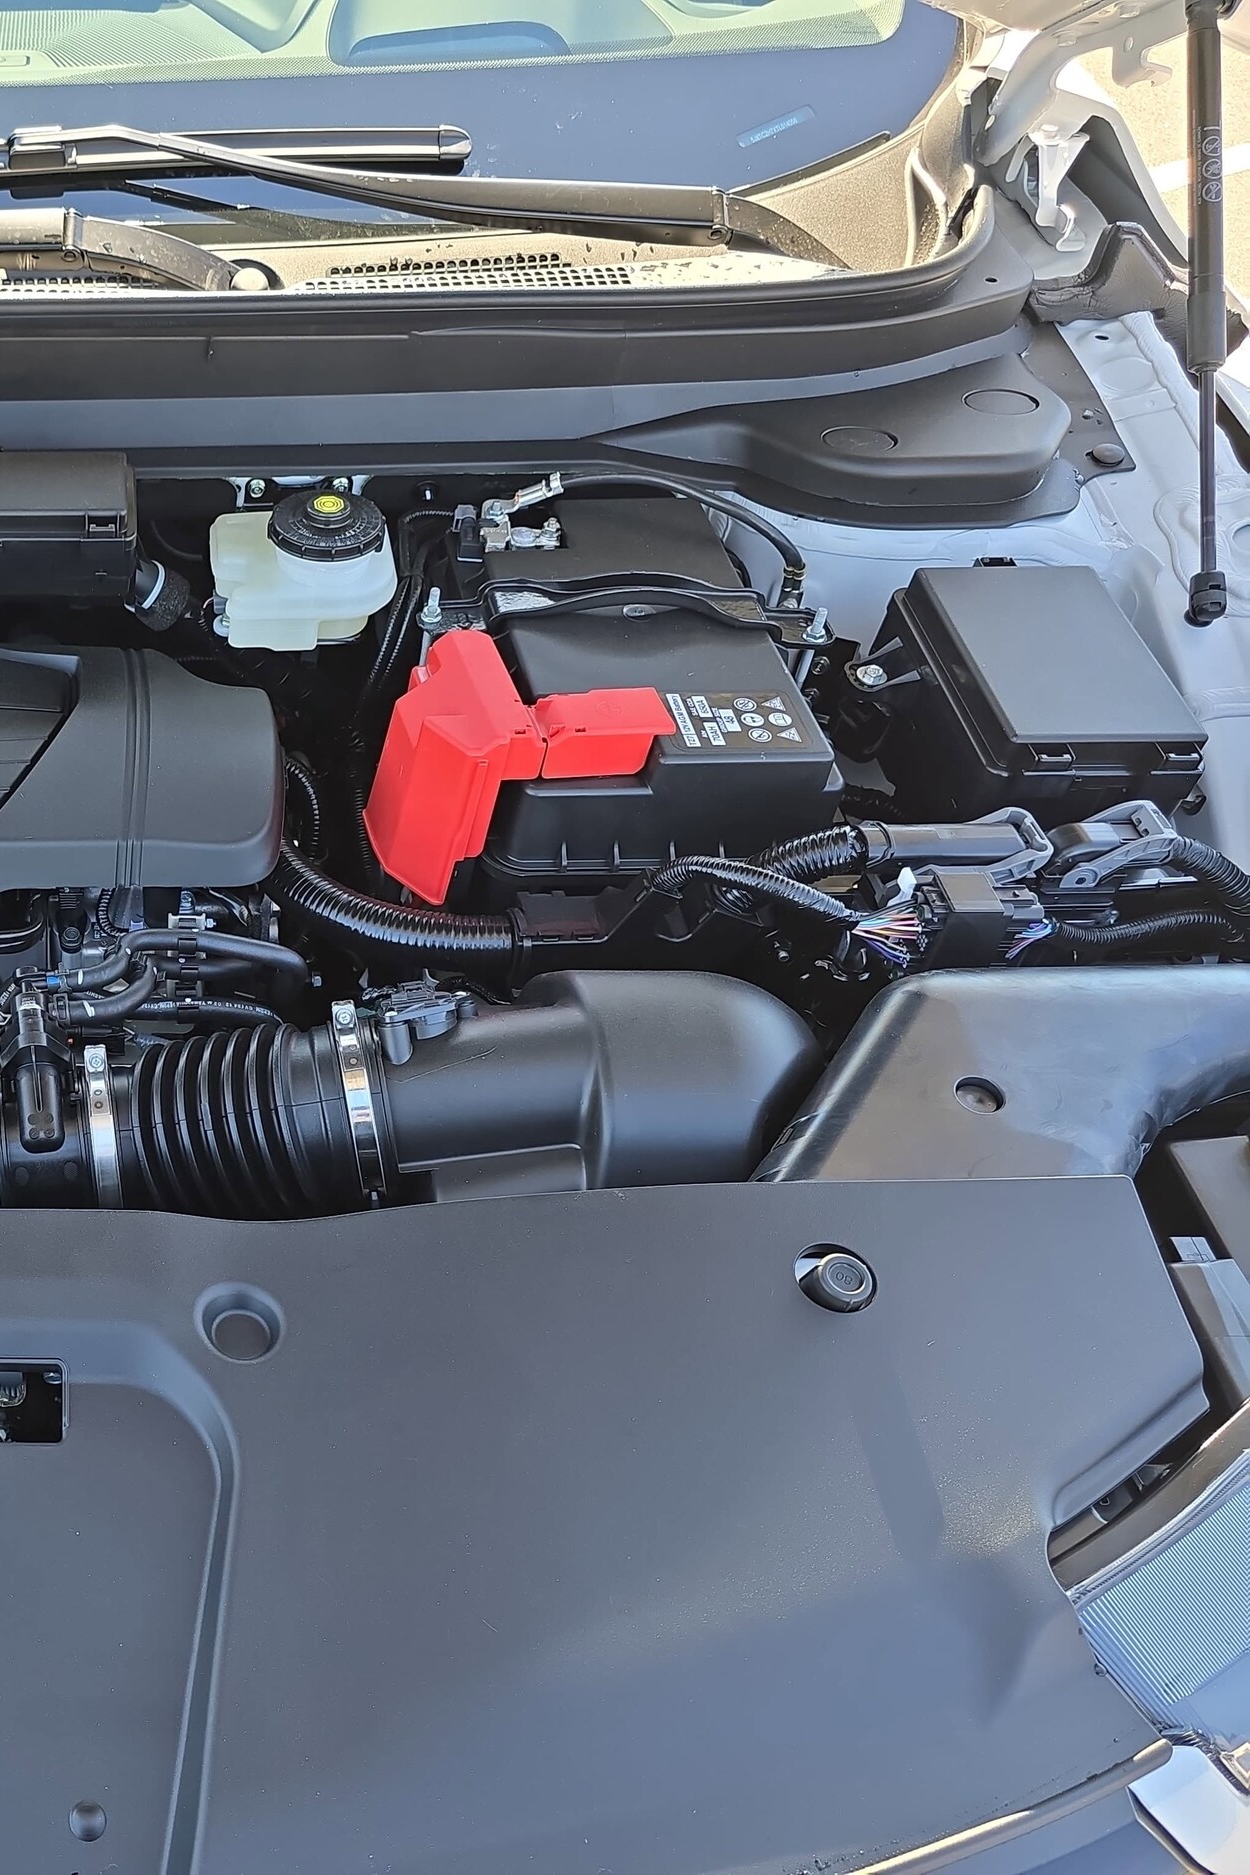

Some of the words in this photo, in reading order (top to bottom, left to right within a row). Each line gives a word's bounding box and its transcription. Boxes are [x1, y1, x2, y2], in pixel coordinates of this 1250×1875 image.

[671, 695, 683, 711] Battery
[676, 711, 688, 724] AGM
[723, 715, 736, 725] 48
[707, 725, 722, 742] 70AH
